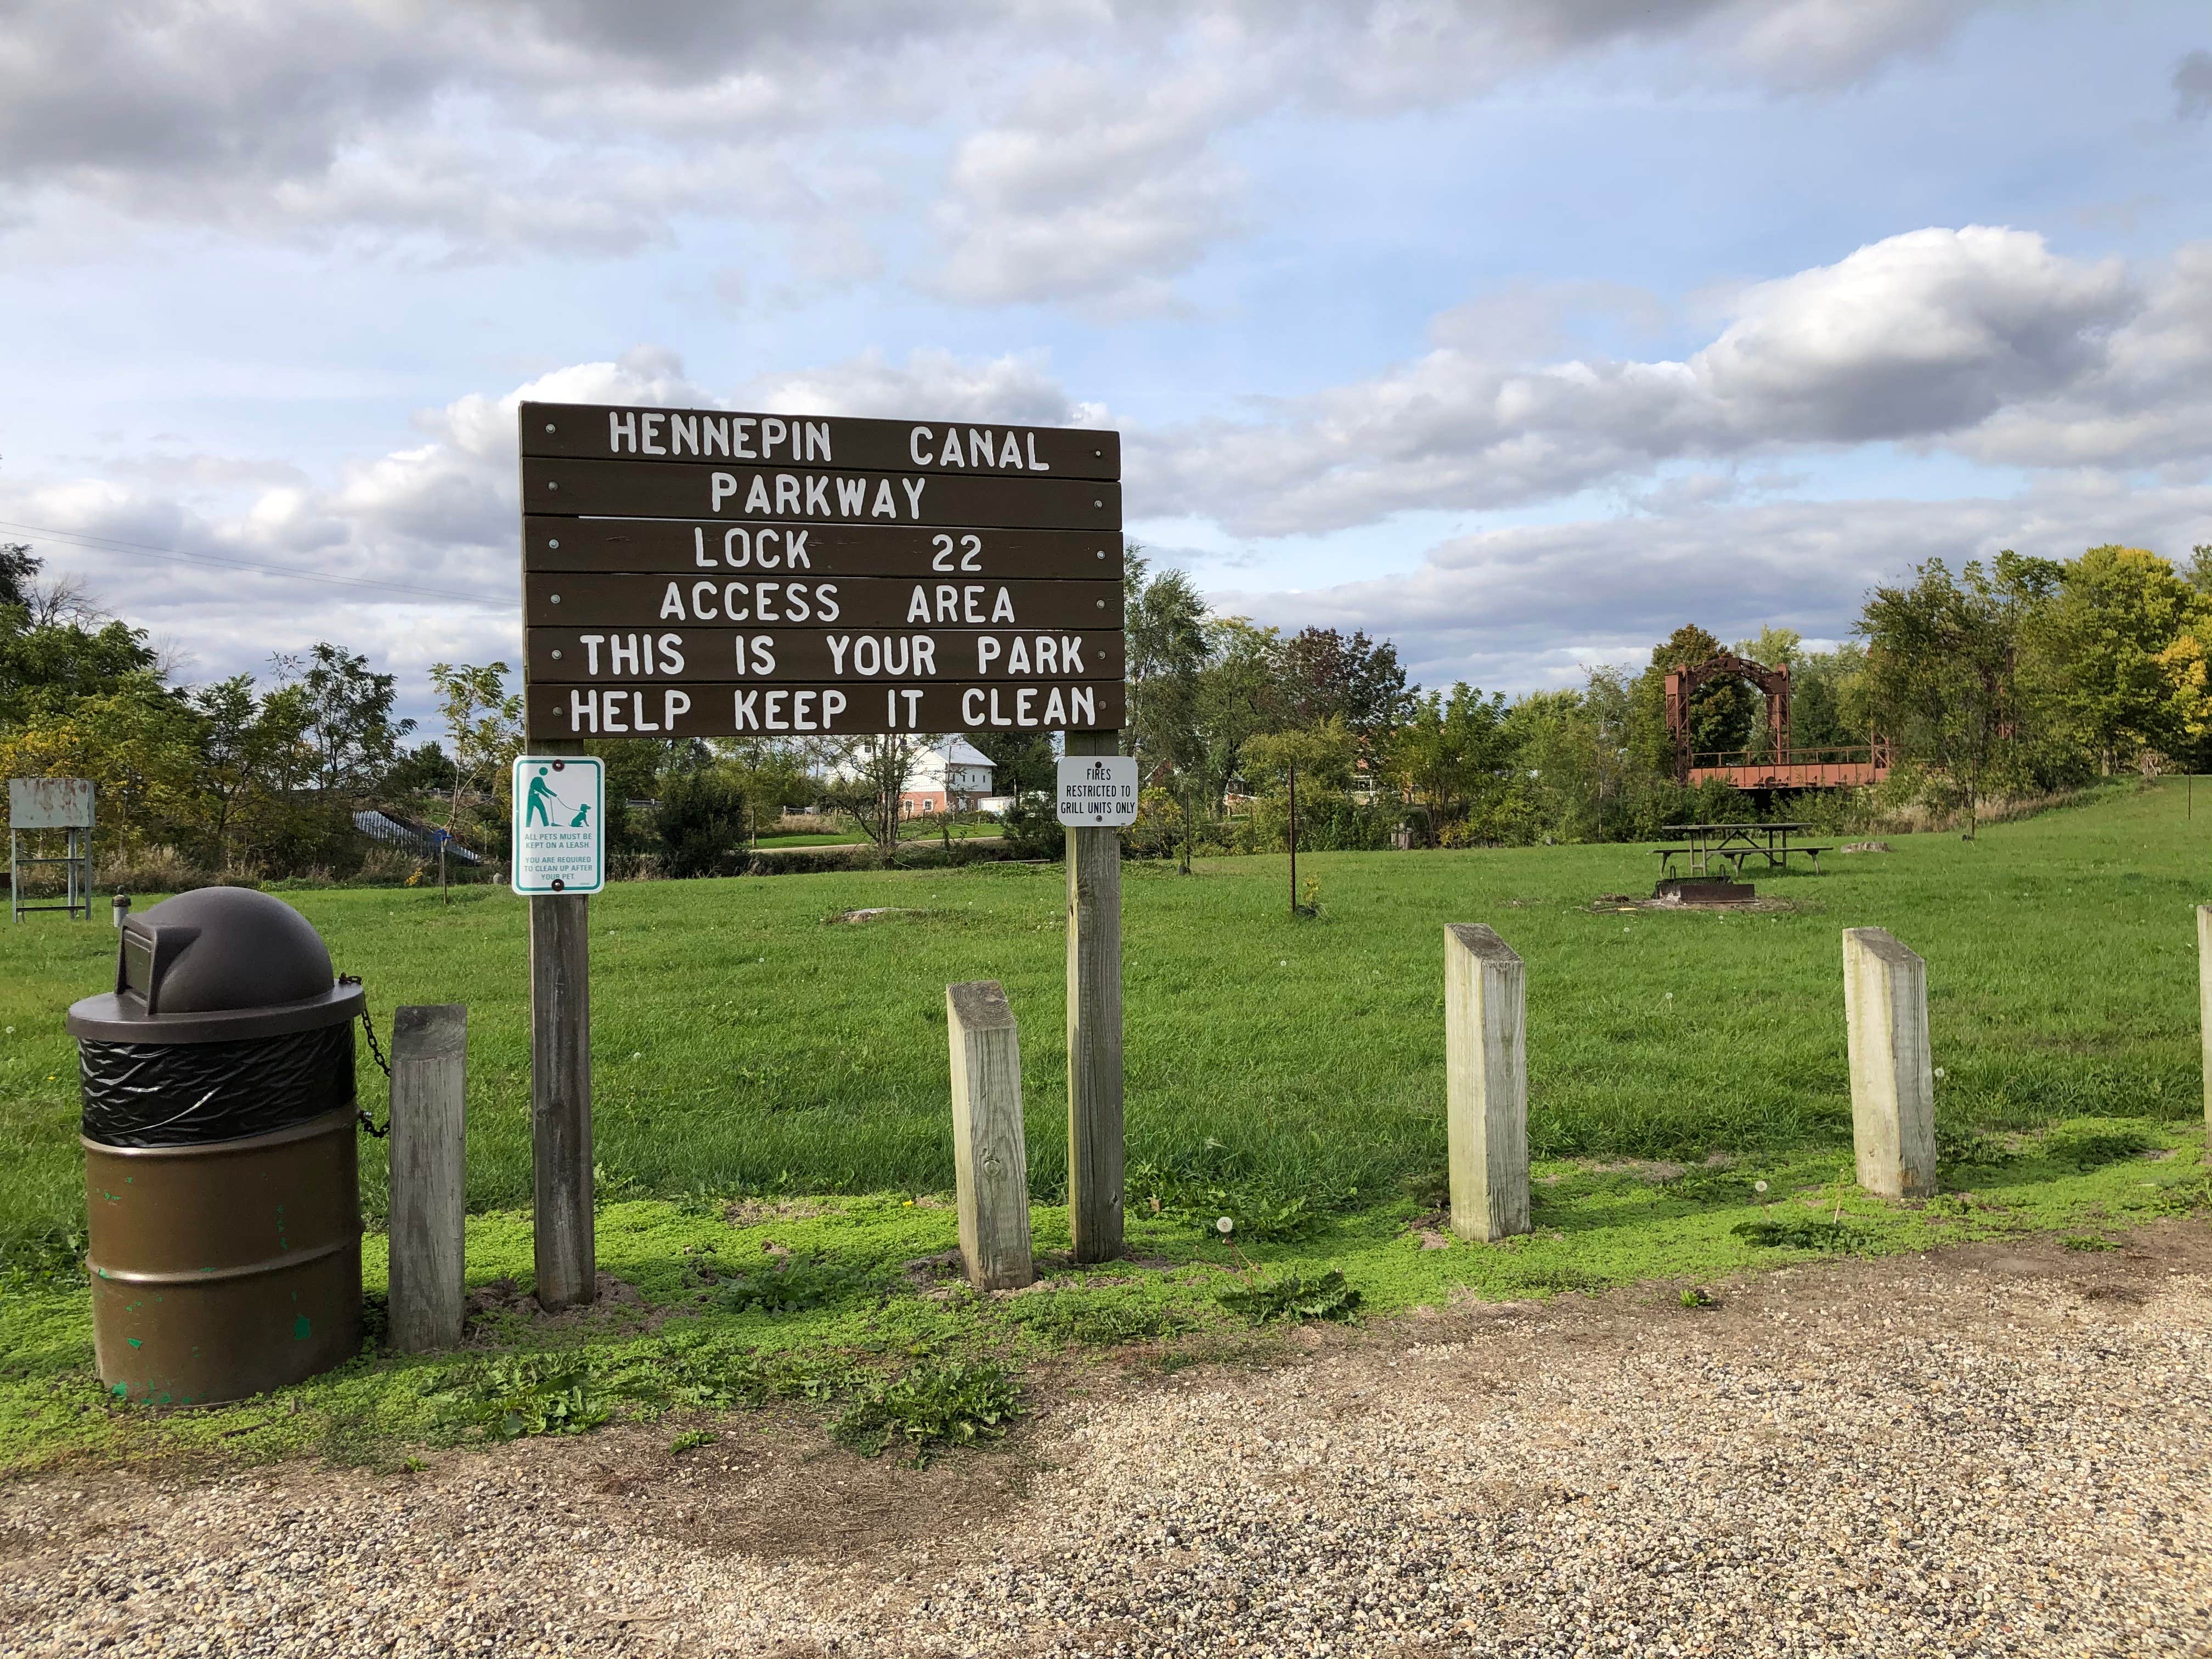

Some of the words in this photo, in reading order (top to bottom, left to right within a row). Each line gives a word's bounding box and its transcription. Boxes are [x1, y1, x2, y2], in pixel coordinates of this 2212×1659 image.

[610, 411, 832, 461] HENNEPIN
[911, 426, 1050, 470] CANAL
[712, 472, 925, 519] PARKWAY
[695, 527, 810, 568] LOCK
[933, 534, 981, 571] 22
[661, 582, 839, 622] ACCESS
[907, 585, 1014, 623] AREA
[580, 634, 684, 675] THIS
[736, 635, 775, 675] IS
[827, 635, 935, 675] YOUR
[978, 636, 1084, 674] PARK
[571, 690, 690, 732] HELP
[735, 690, 846, 730] KEEP
[888, 690, 923, 728] IT
[963, 687, 1095, 726] CLEAN
[1066, 786, 1116, 797] RESTRICTED
[1121, 786, 1130, 797] TO
[1087, 769, 1111, 780] FIRES
[1061, 802, 1084, 814] GRILL
[1088, 802, 1111, 814] UNITS
[1116, 802, 1135, 813] ONLY
